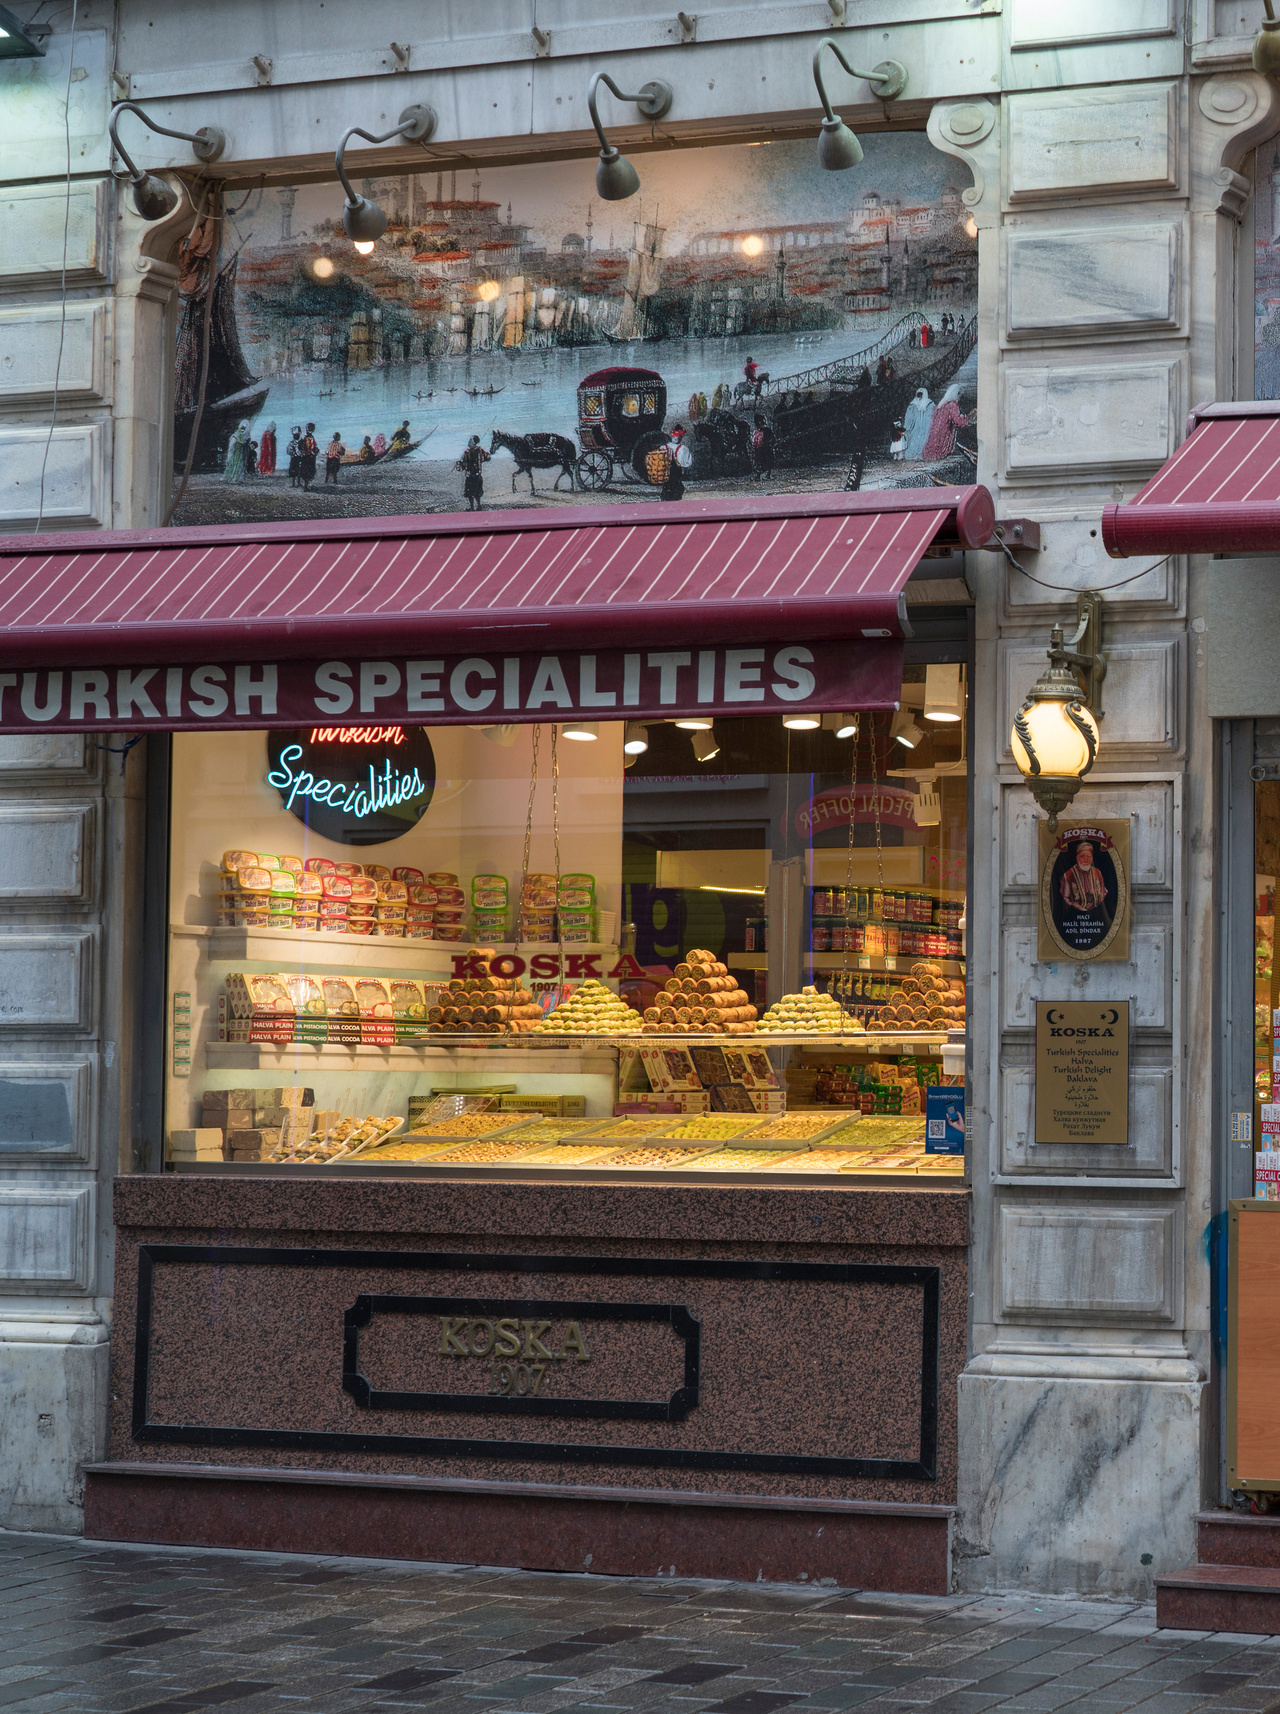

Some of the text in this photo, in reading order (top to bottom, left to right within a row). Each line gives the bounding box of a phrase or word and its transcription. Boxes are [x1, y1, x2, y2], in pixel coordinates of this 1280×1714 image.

[314, 646, 816, 714] SPECIALITIES
[268, 744, 425, 818] Specialities
[1063, 829, 1105, 839] KOSKA
[451, 954, 647, 979] KOSKA
[530, 982, 558, 992] 1907
[1050, 1028, 1114, 1037] KOSKA
[1046, 1048, 1119, 1058] Turkish Specialities
[1085, 1066, 1111, 1075] Delight
[1263, 1123, 1280, 1133] SPECIAL
[1256, 1171, 1276, 1180] SPECIAL
[439, 1316, 591, 1361] KOSKA
[488, 1364, 546, 1396] 1907
